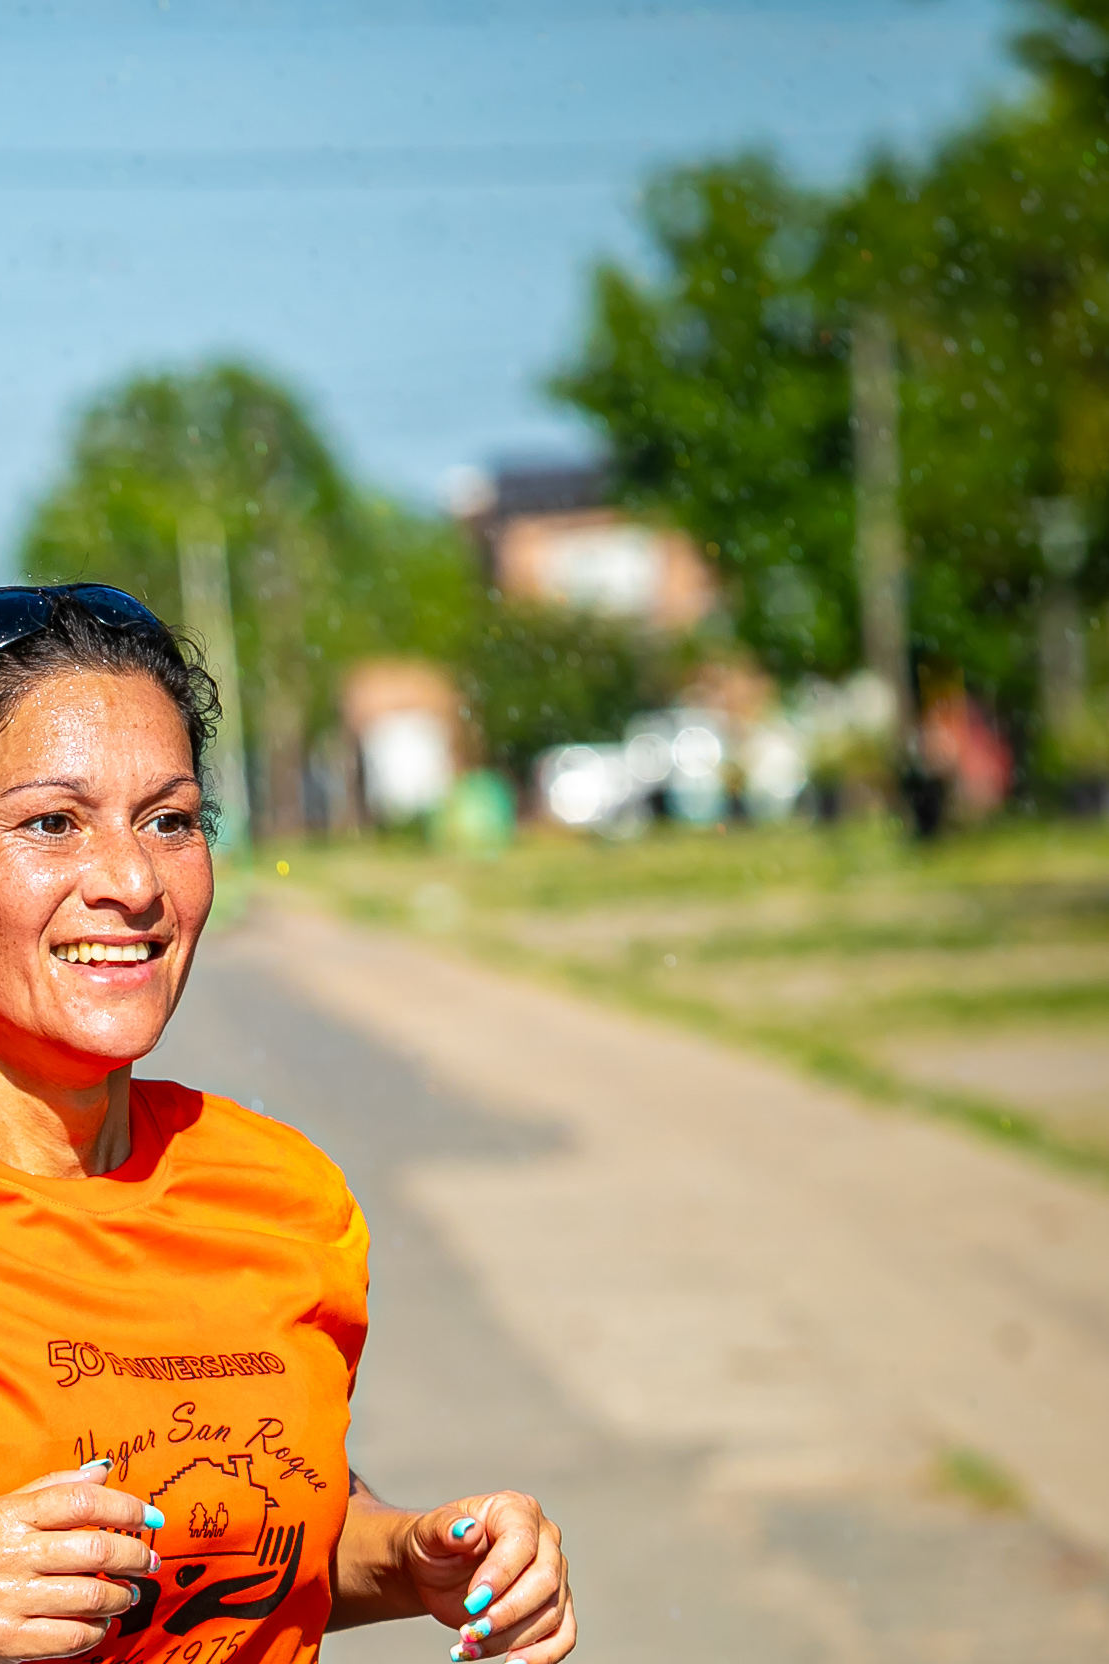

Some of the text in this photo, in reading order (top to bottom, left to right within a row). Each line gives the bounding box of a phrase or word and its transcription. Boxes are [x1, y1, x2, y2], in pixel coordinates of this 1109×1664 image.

[105, 1351, 286, 1381] ANIVERSARIO
[73, 1401, 328, 1493] Hogar San Roque
